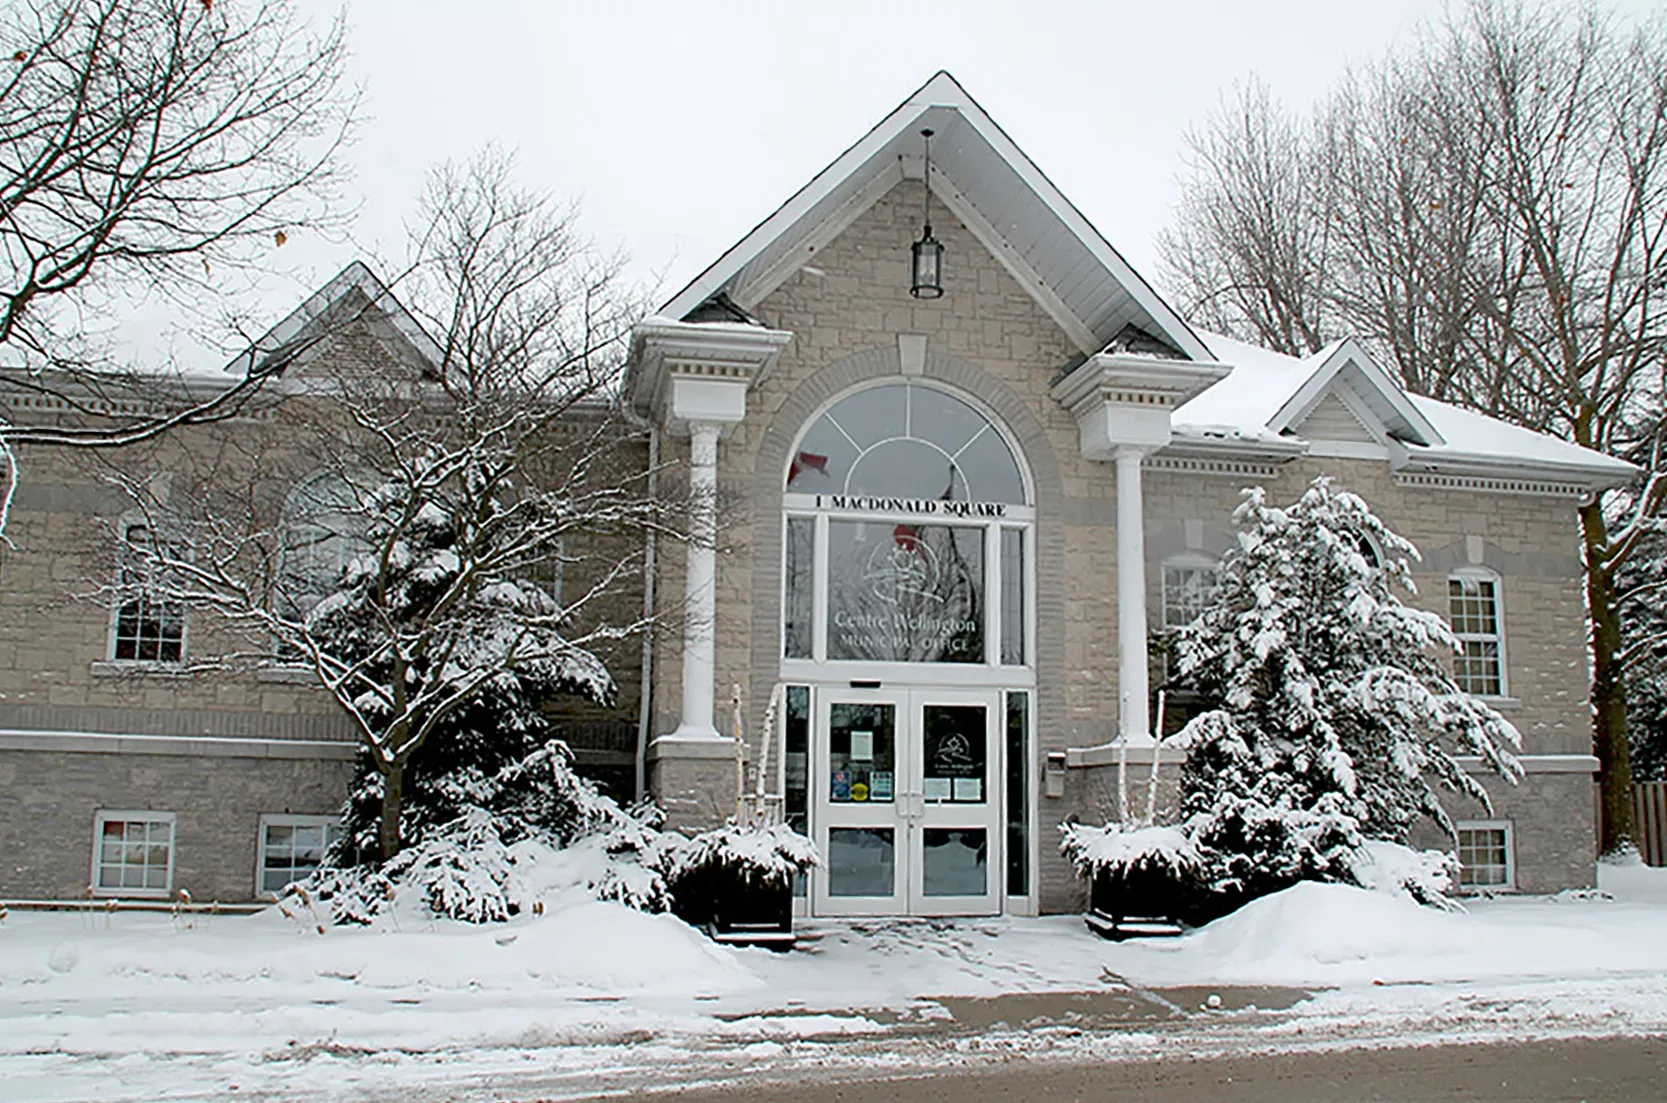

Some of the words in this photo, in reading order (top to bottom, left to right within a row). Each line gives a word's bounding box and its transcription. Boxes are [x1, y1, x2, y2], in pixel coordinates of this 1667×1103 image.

[832, 495, 937, 513] MACDONALD
[943, 501, 1007, 518] SQUARE
[834, 611, 888, 629] Centre
[892, 612, 977, 637] Wellington
[921, 637, 969, 652] OFFICE
